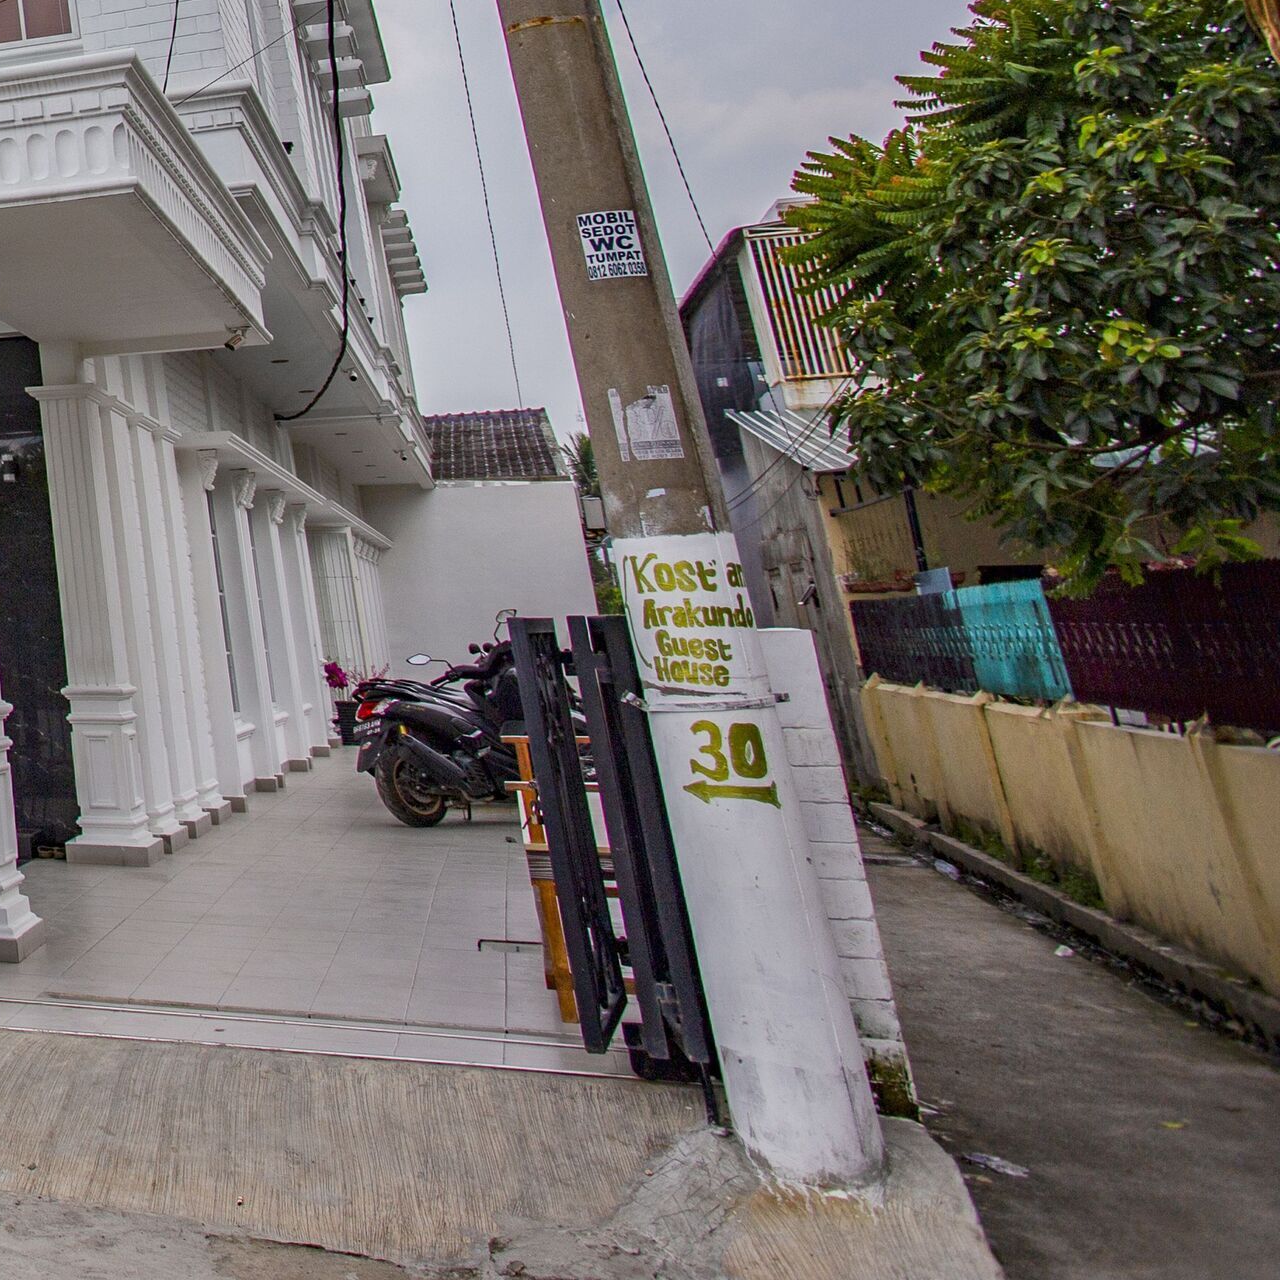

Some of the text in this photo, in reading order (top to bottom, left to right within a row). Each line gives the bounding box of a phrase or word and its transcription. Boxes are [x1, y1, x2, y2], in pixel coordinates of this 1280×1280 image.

[578, 212, 634, 227] MOBIL
[582, 224, 635, 238] SEDOT
[589, 235, 634, 252] WC
[587, 251, 641, 264] TUMPAT
[588, 265, 607, 278] 0812
[643, 592, 754, 629] Arakundo
[655, 629, 732, 661] Guest
[653, 656, 729, 687] House
[690, 720, 768, 781] 30
